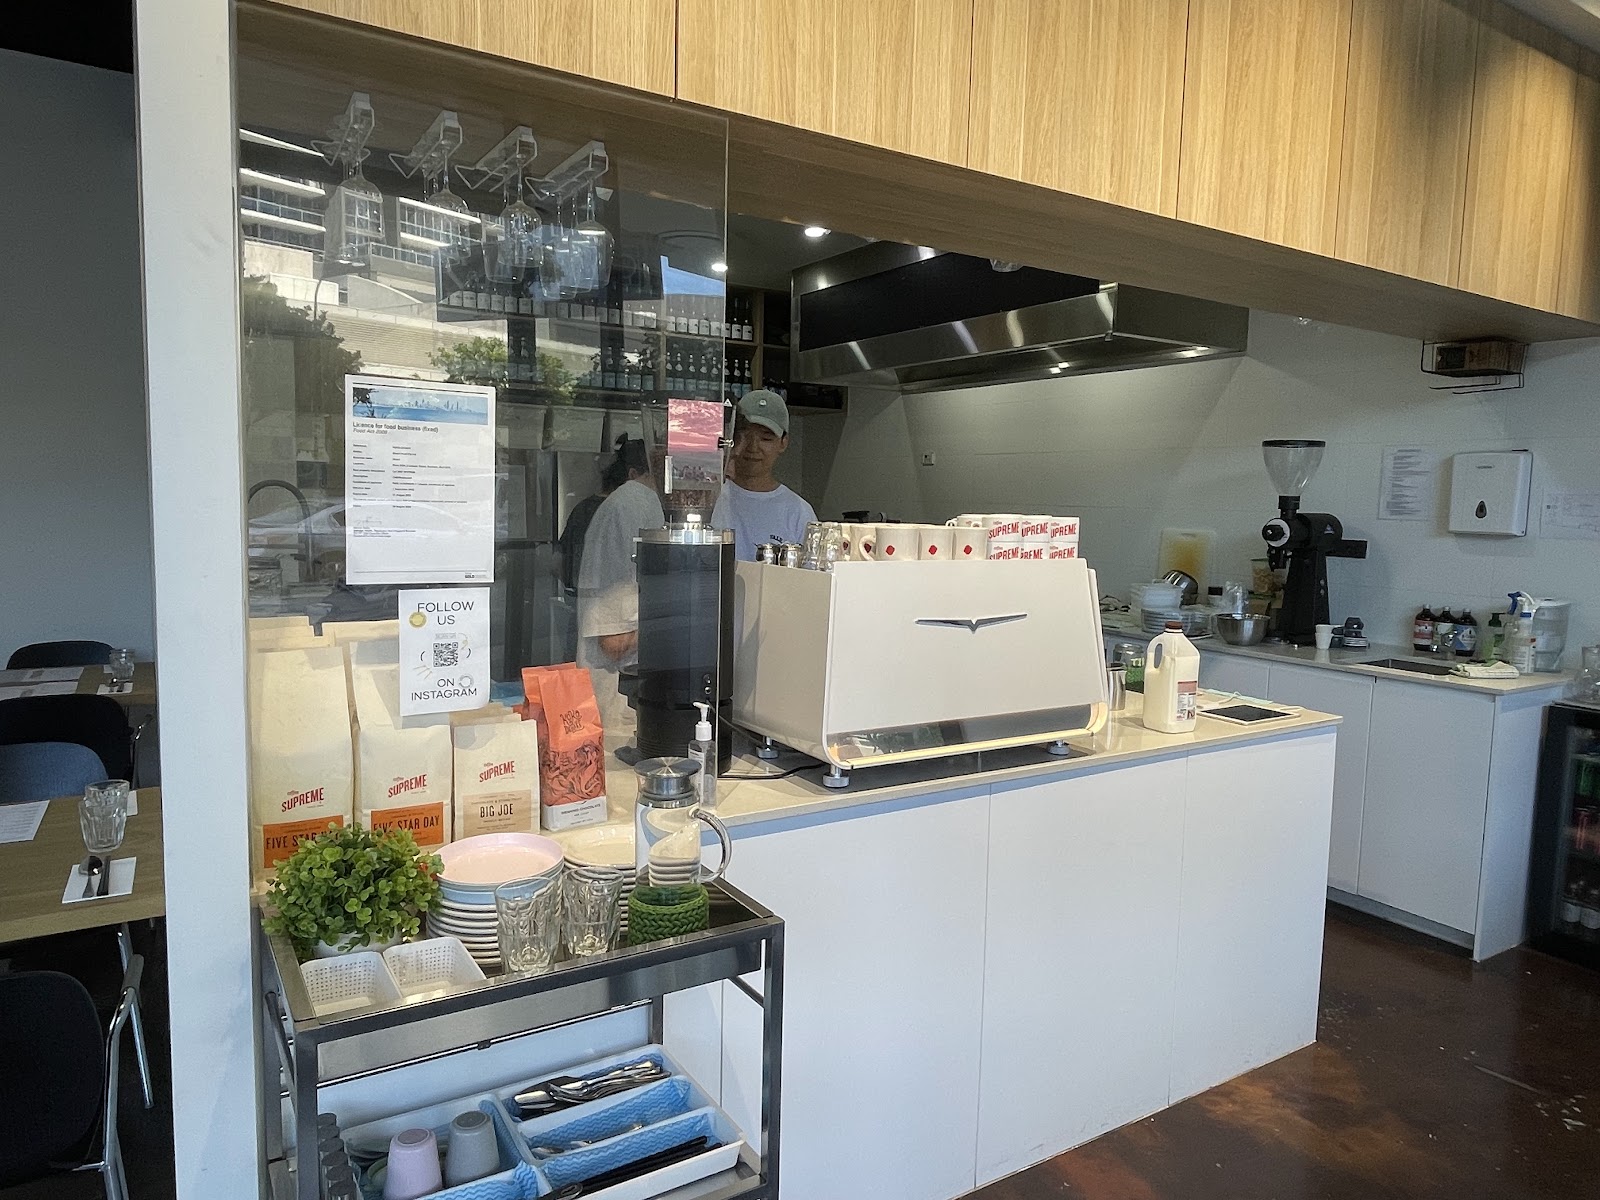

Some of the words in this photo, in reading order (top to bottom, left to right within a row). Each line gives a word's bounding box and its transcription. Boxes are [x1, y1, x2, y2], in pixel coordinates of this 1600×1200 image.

[352, 421, 374, 429] Licence
[988, 521, 1020, 539] SUPREME
[1021, 522, 1049, 537] UPREME
[1050, 523, 1077, 538] UPREME
[1021, 548, 1043, 560] PREME
[1049, 547, 1075, 559] UPREME
[417, 601, 474, 613] FOLLOW
[437, 614, 455, 625] US
[437, 678, 455, 688] ON
[411, 688, 477, 701] INSTAGRAM
[479, 760, 515, 783] SUPREME
[388, 773, 427, 798] SUPREME
[281, 787, 325, 813] SUPREME
[480, 805, 495, 818] BIG
[498, 803, 514, 816] JOE
[397, 817, 420, 831] STAR
[423, 815, 440, 829] DAY
[266, 835, 288, 849] FIVE
